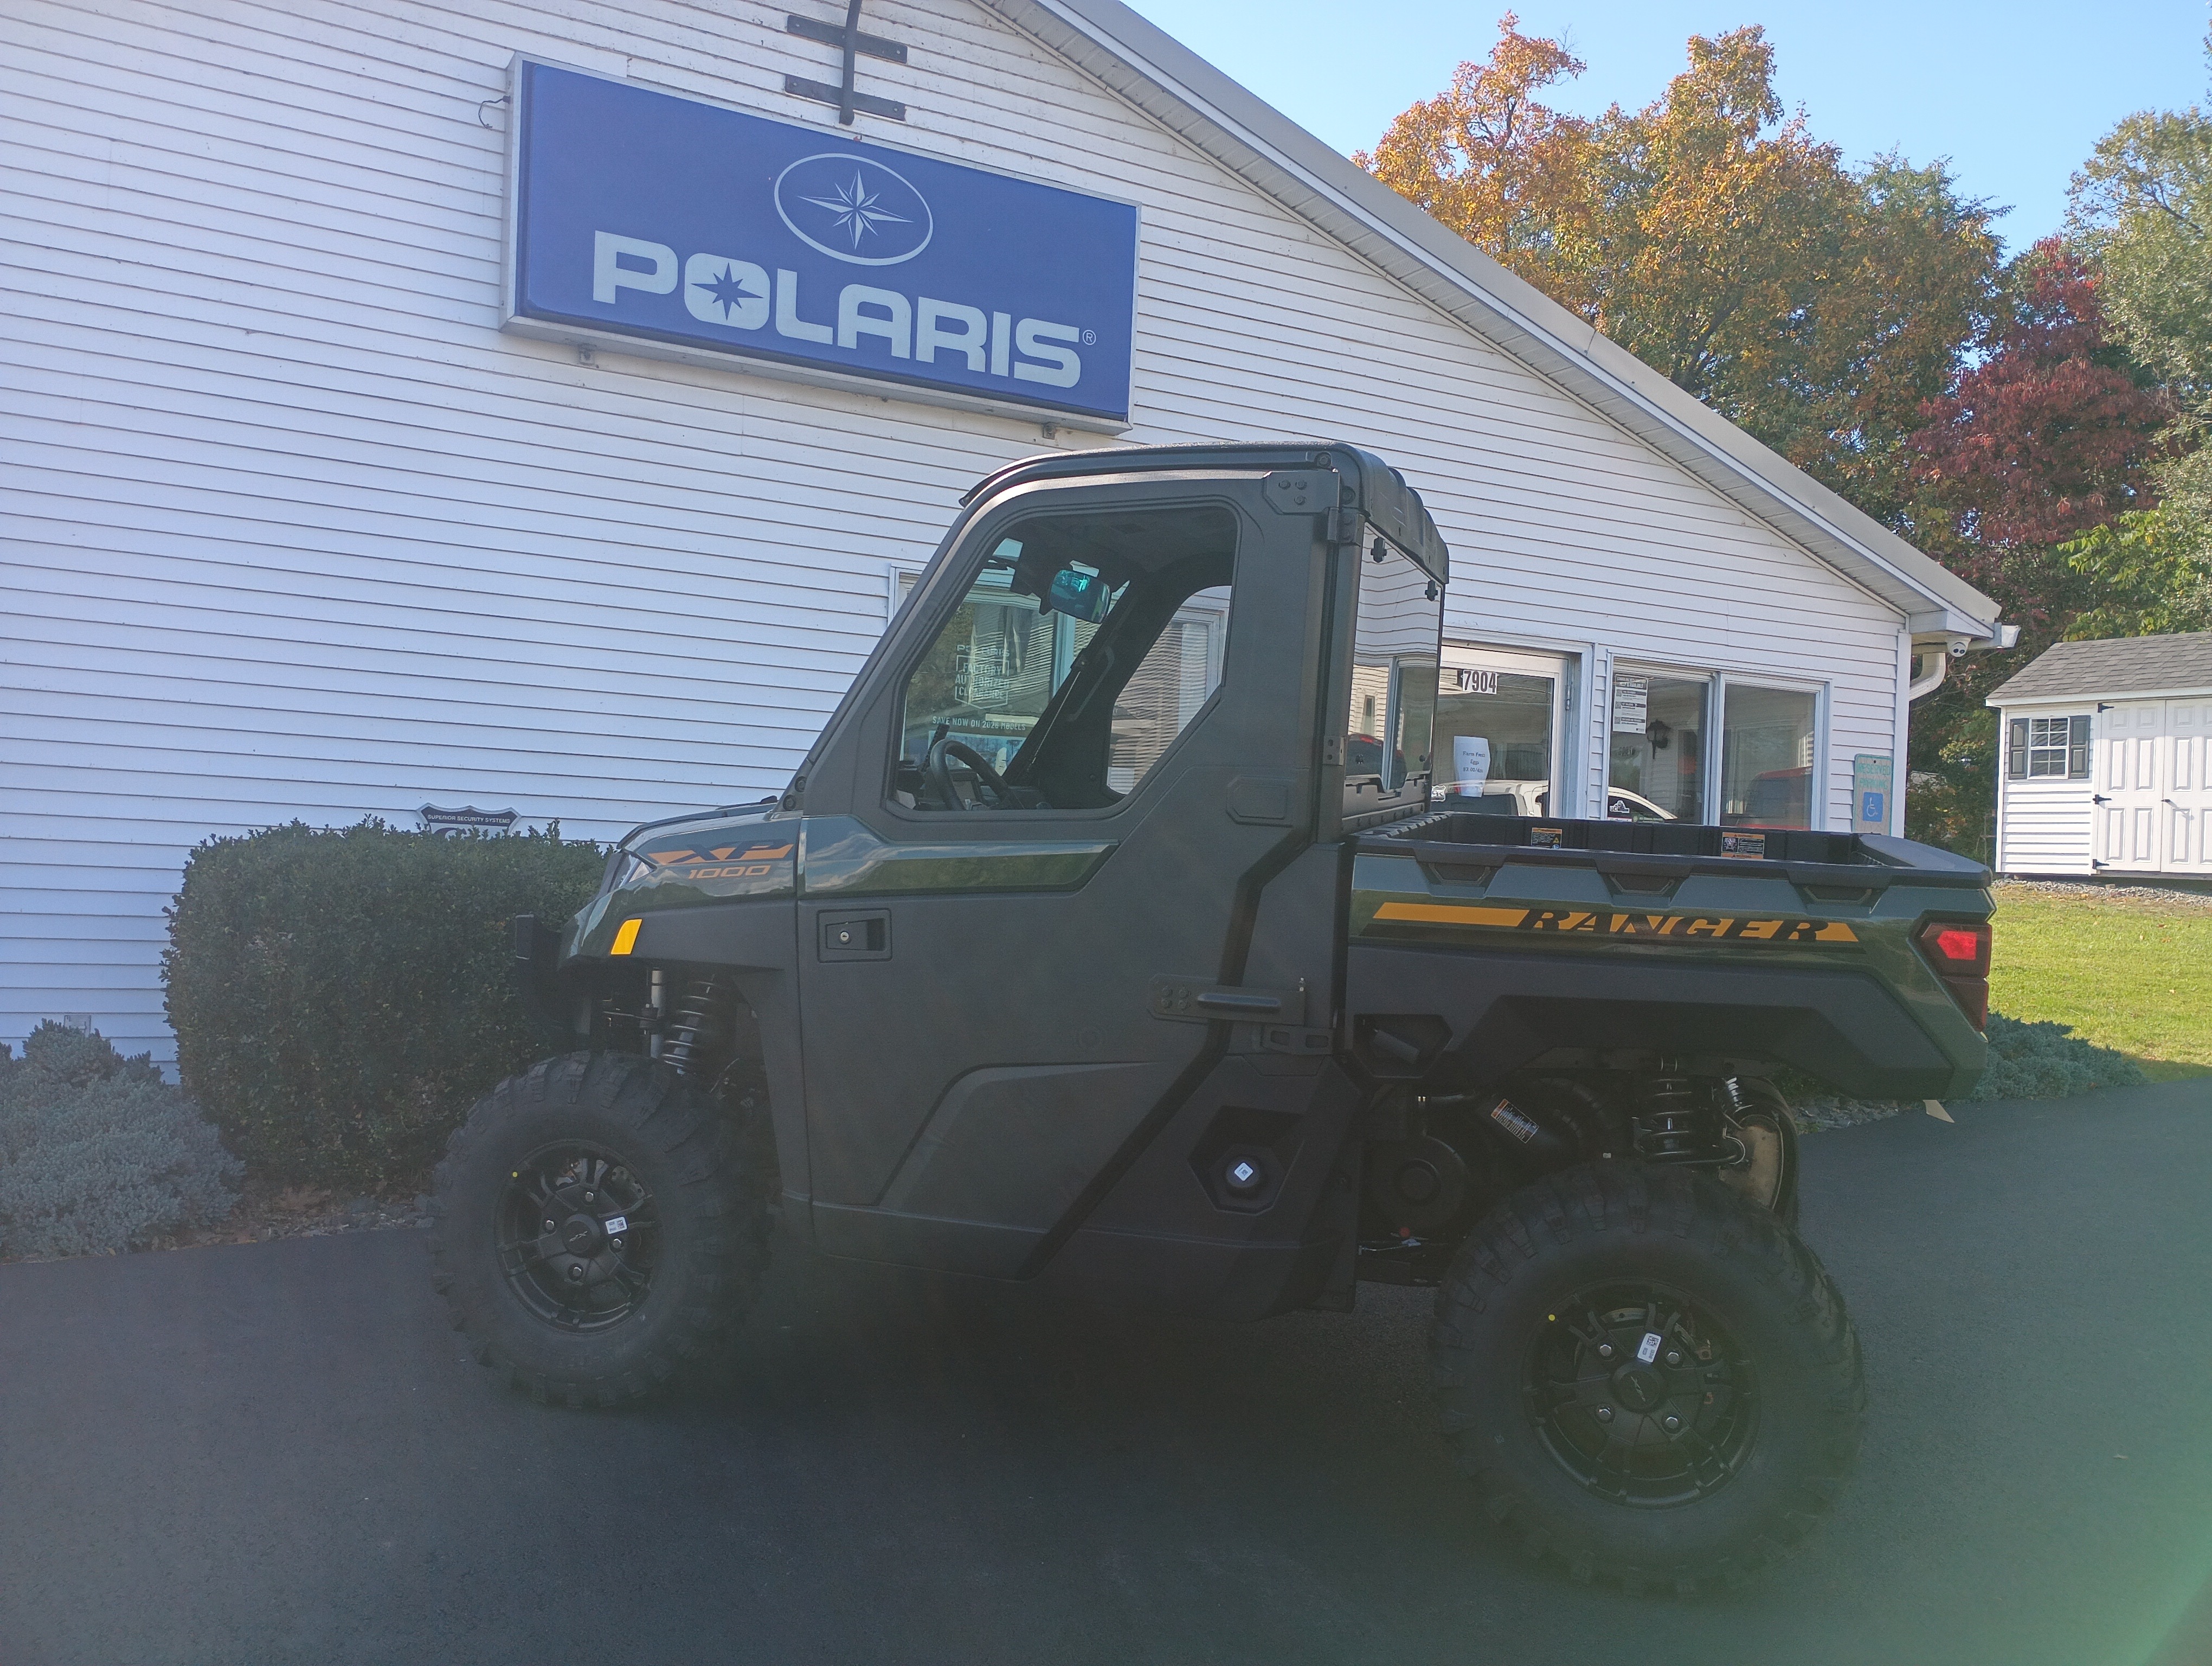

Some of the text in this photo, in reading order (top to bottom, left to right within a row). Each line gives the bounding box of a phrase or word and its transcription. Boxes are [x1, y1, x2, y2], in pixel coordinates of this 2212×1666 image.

[593, 230, 1081, 388] POLARIS
[1464, 670, 1496, 693] 7904
[933, 716, 950, 725] SAVE
[953, 717, 968, 726] NOW
[971, 720, 980, 728] ON
[1000, 722, 1026, 731] MODELS
[1856, 764, 1891, 776] RESERVED
[688, 865, 771, 879] 1000
[1518, 909, 1829, 942] RANGER
